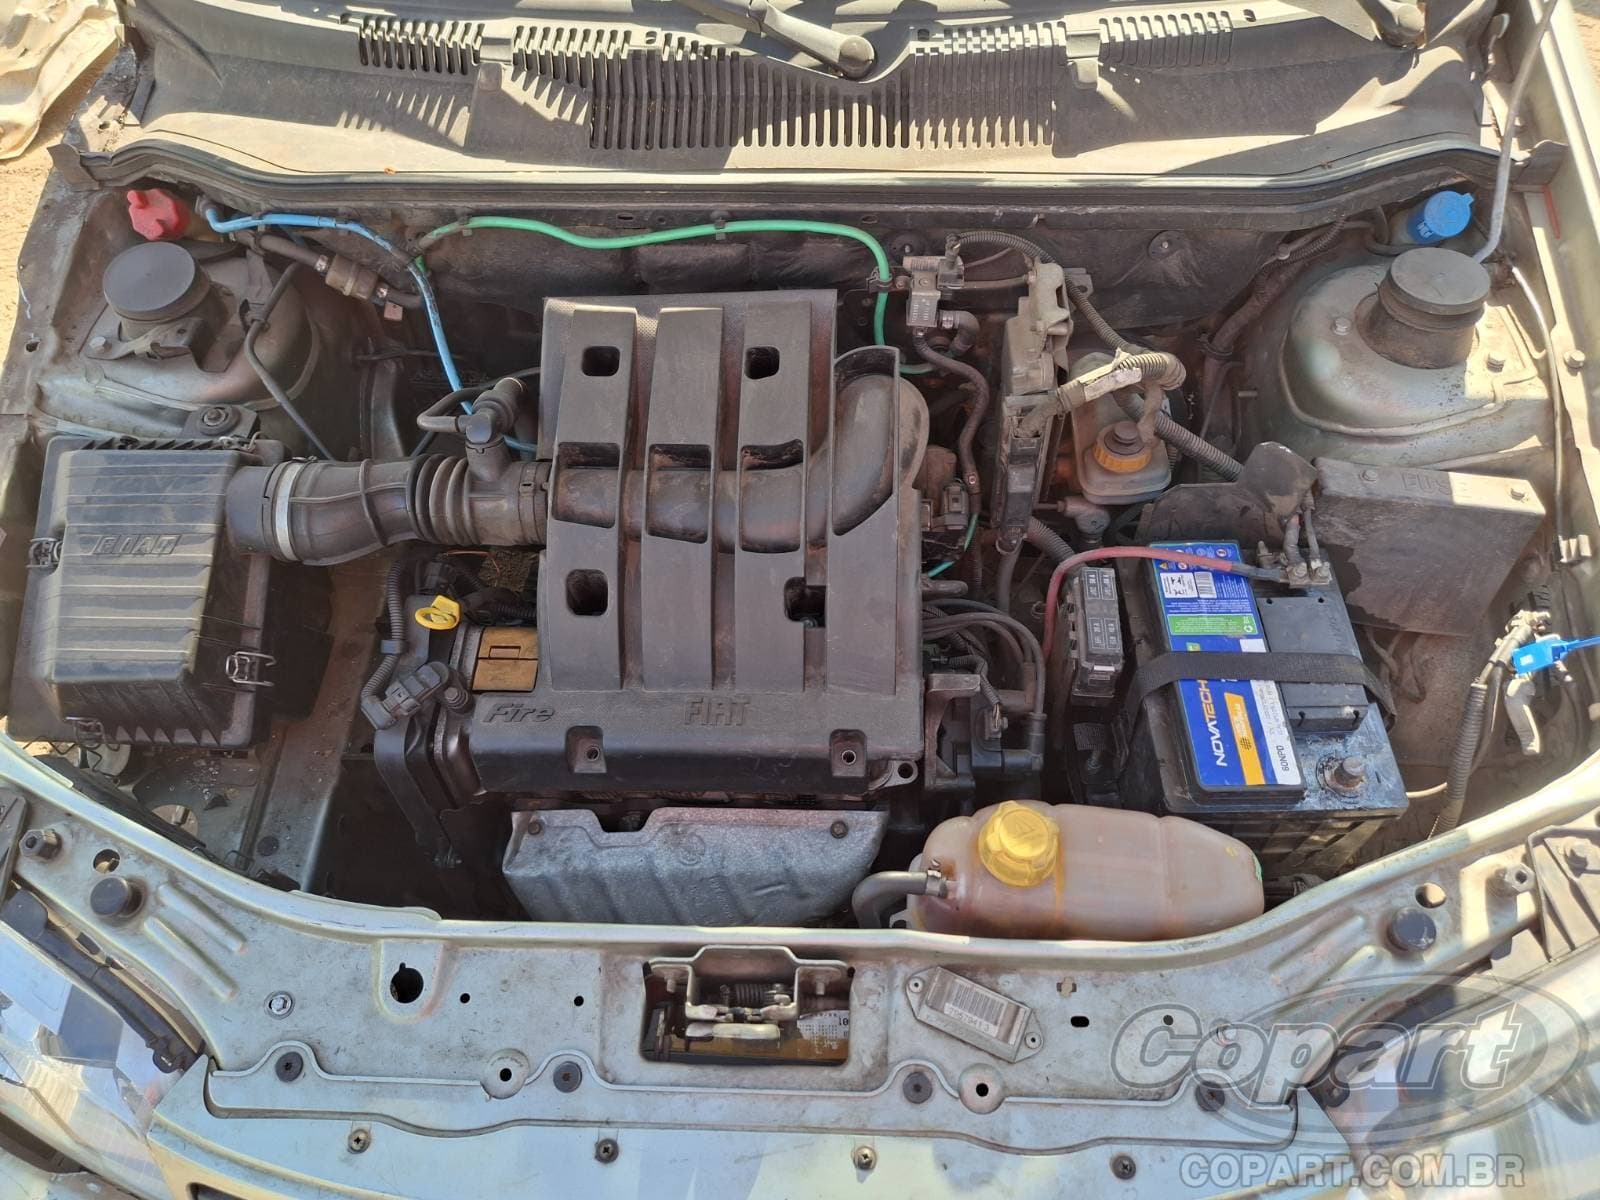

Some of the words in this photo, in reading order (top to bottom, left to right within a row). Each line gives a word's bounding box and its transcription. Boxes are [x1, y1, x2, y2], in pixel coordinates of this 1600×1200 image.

[99, 536, 177, 554] FIAT
[483, 702, 556, 722] Fire
[683, 697, 750, 726] FIAT
[1196, 680, 1228, 767] NOVATECH
